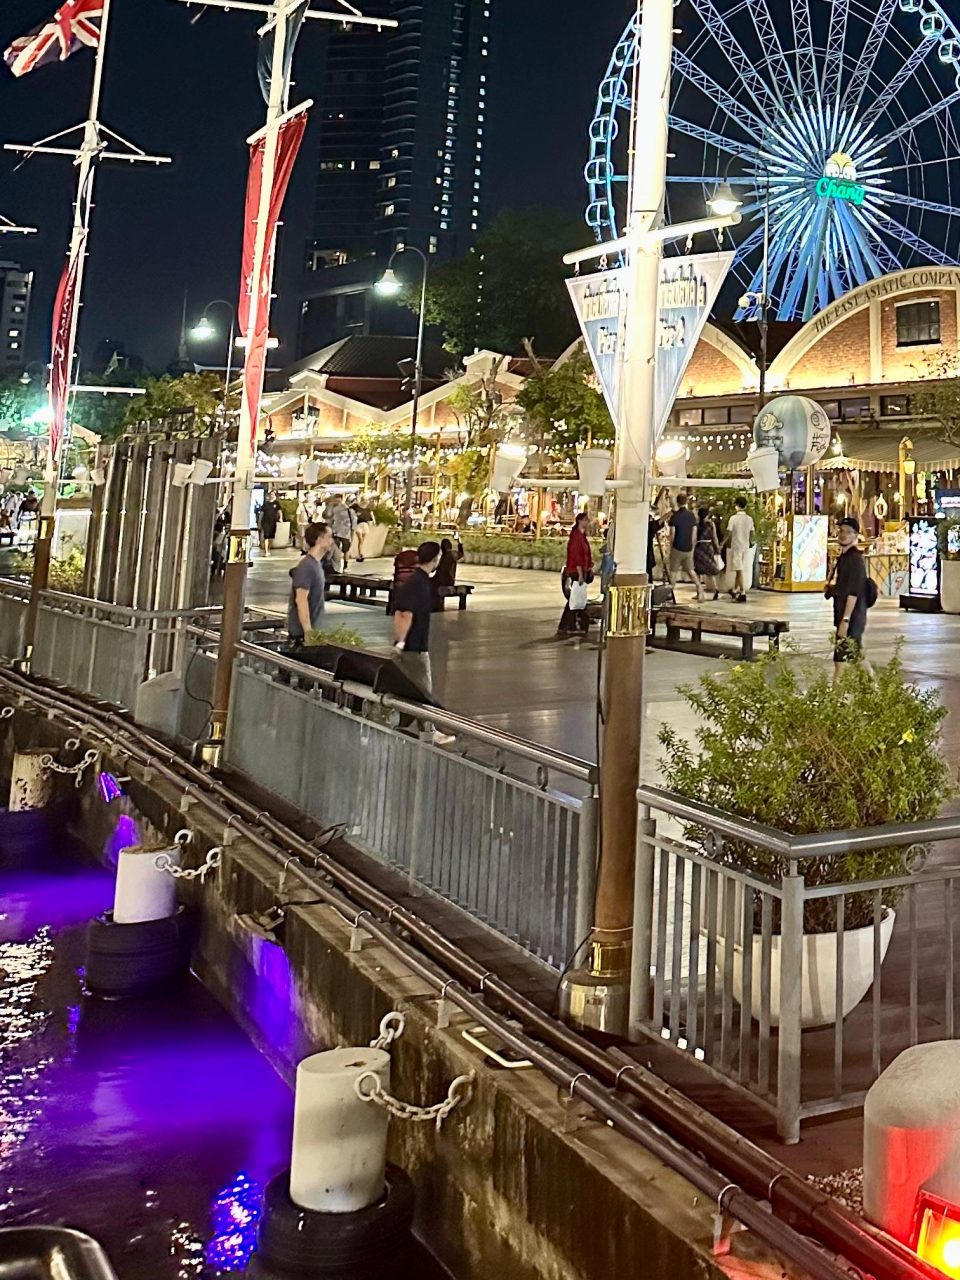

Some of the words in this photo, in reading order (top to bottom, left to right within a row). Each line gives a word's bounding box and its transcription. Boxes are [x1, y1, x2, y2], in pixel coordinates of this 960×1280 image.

[816, 177, 865, 205] Chang
[813, 310, 833, 333] THE
[834, 292, 860, 319] EAST
[864, 275, 908, 303] ASIATIC
